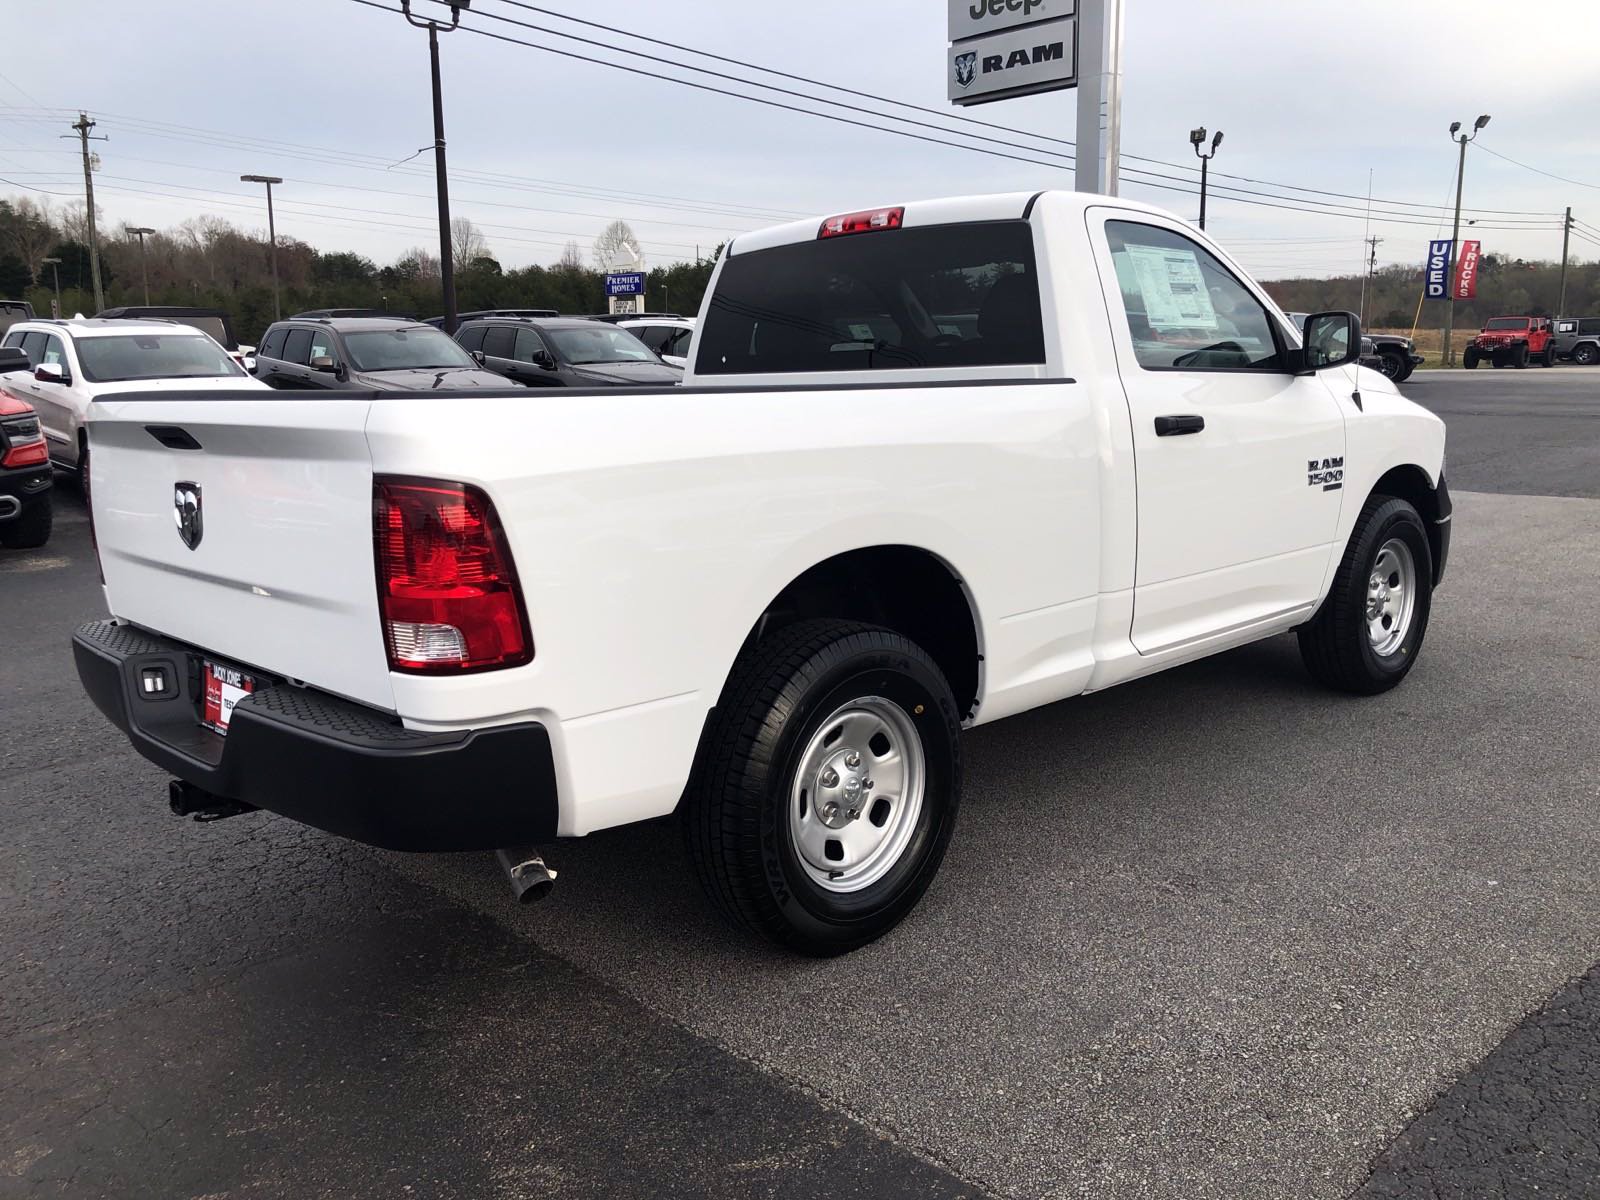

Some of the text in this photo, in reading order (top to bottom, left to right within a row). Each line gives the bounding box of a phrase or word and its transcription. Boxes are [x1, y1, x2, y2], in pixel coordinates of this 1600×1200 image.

[982, 41, 1063, 74] RAM
[1428, 243, 1448, 296] USED
[1459, 243, 1479, 297] TRUCKS
[1307, 456, 1344, 472] RAM
[1307, 469, 1343, 486] 1500
